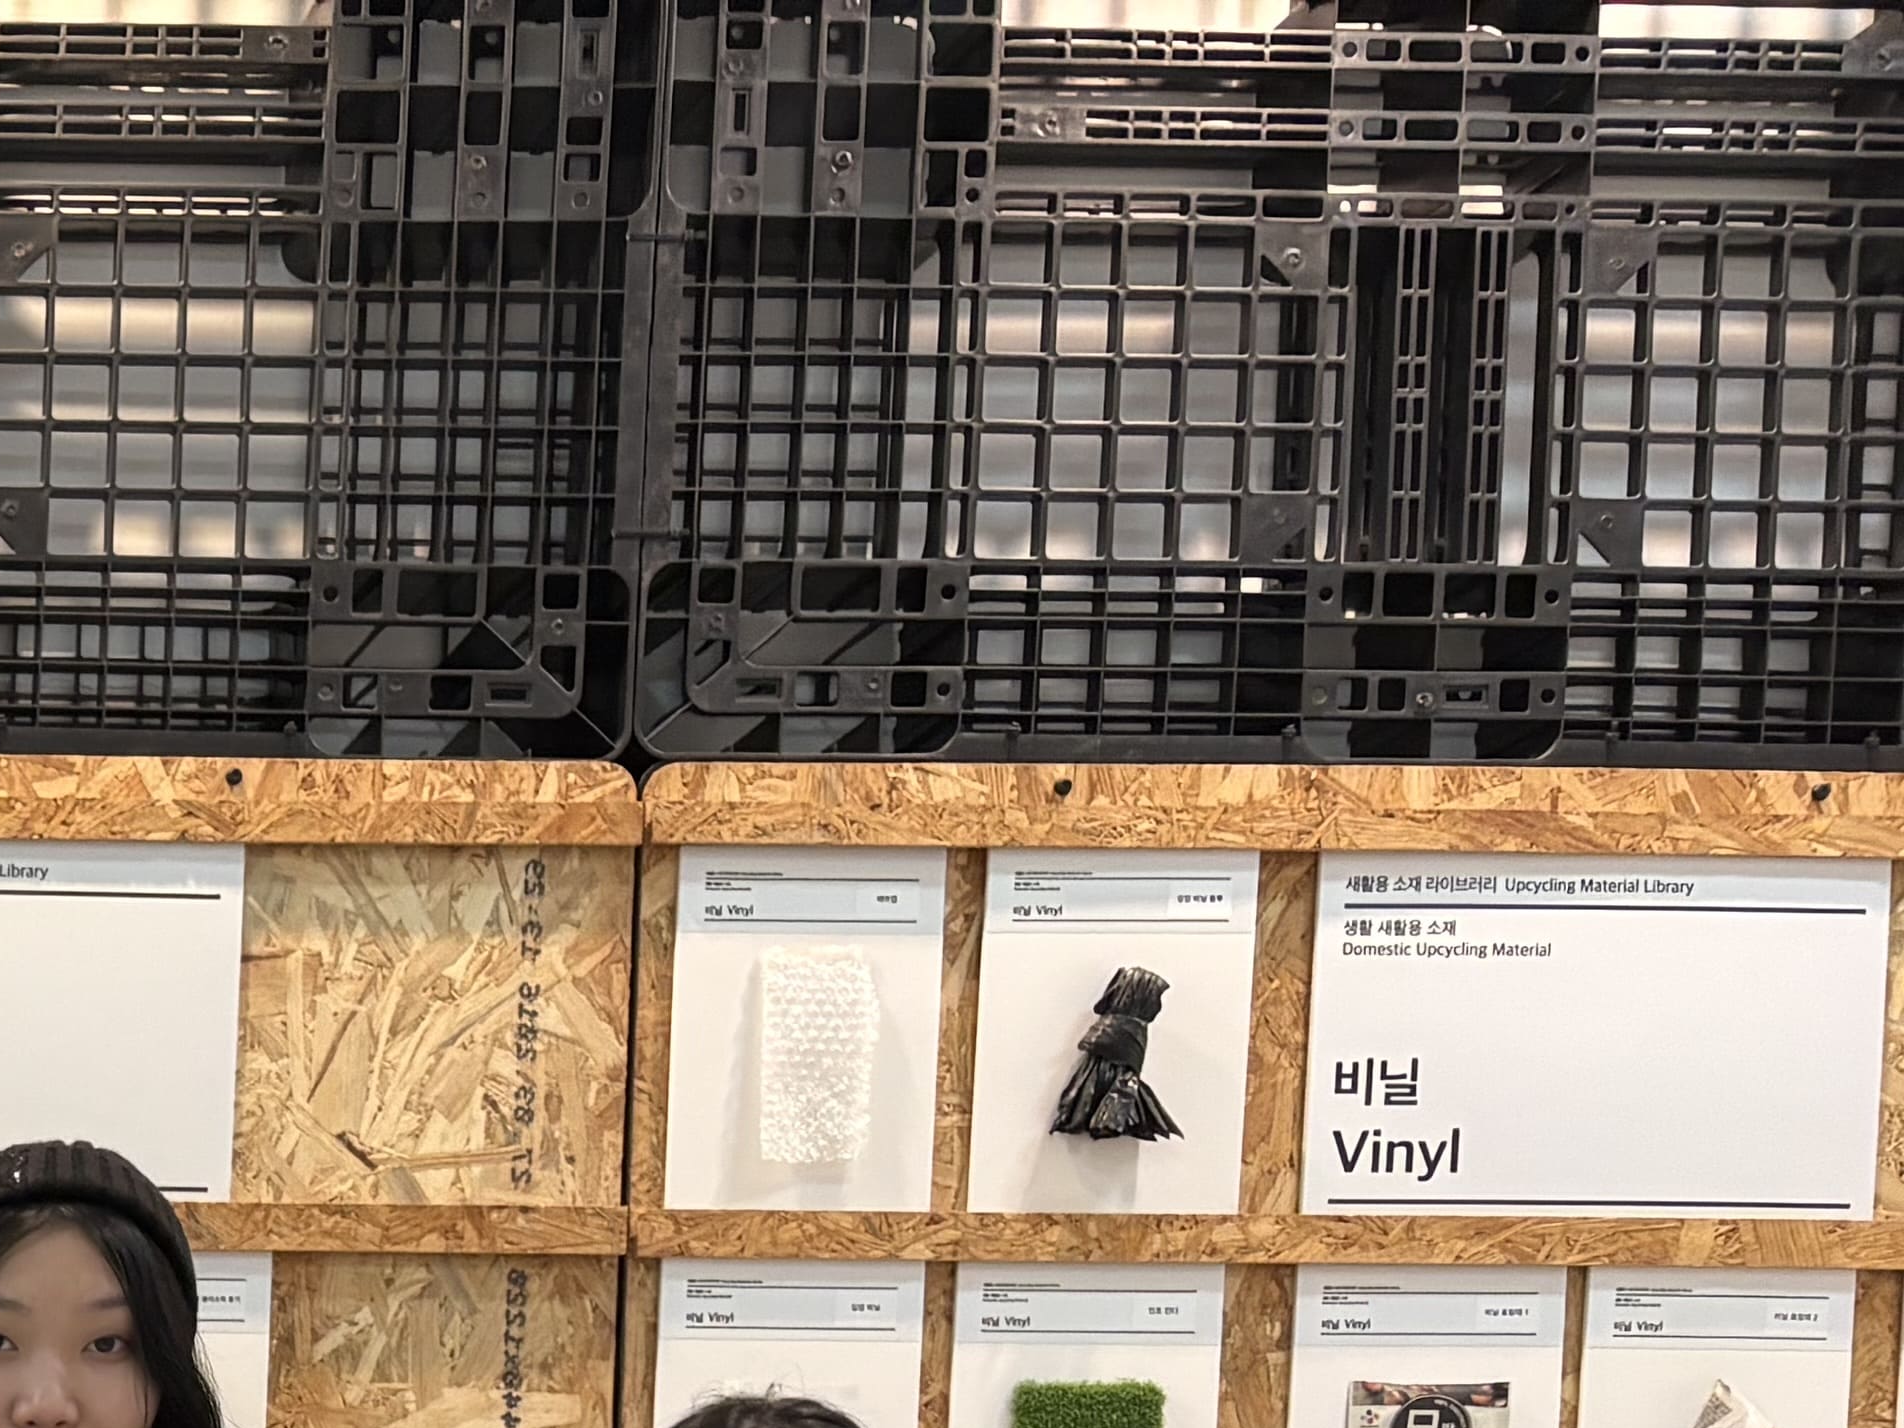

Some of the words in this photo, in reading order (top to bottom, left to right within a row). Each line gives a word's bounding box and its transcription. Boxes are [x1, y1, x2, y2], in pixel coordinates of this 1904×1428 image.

[0, 864, 48, 880] Library
[1346, 876, 1388, 892] 새활용
[1393, 876, 1421, 892] 소재
[1426, 875, 1496, 893] 라이브러리
[1505, 878, 1575, 894] Upcycling
[1581, 879, 1639, 893] Material
[1644, 880, 1694, 896] Library
[727, 905, 753, 916] Vinyl
[1036, 905, 1062, 916] Vinyl
[1344, 920, 1372, 936] 생활
[1378, 920, 1421, 936] 새활용
[1427, 920, 1456, 936] 소재
[1343, 942, 1411, 956] Domestic
[1417, 942, 1487, 958] Upcycling
[1493, 943, 1551, 956] Material
[1335, 1058, 1418, 1106] 비닐
[1333, 1128, 1460, 1181] Vinyl
[708, 1312, 734, 1324] Vinyl
[1005, 1316, 1030, 1328] Vinyl
[1345, 1319, 1370, 1330] Vinyl
[1637, 1321, 1663, 1332] Vinyl
